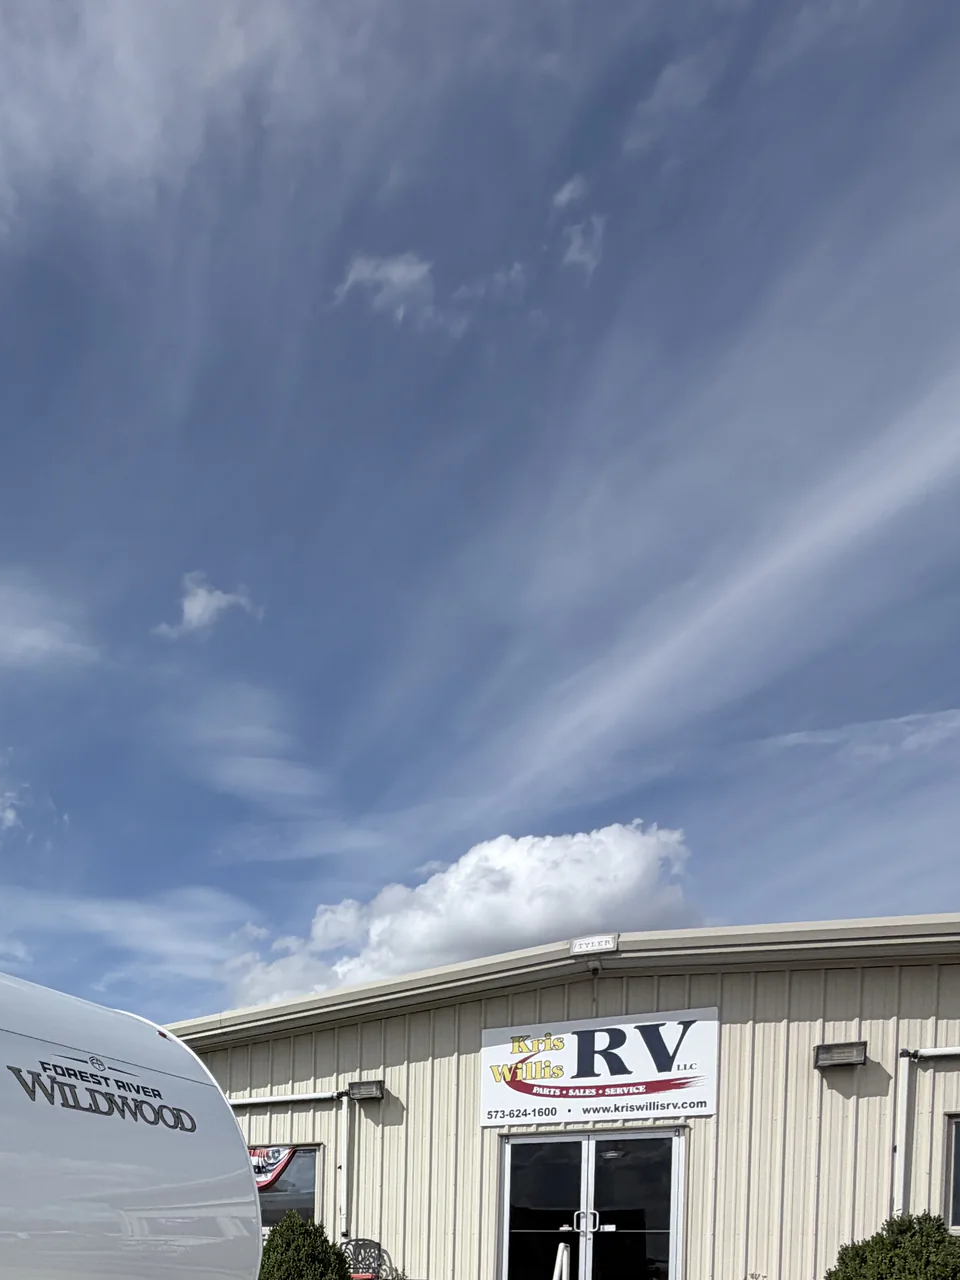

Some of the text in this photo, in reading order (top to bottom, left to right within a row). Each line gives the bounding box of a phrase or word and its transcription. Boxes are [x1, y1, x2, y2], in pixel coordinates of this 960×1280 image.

[578, 939, 611, 949] TYLER
[510, 1032, 565, 1055] Kris
[570, 1020, 698, 1080] RV
[489, 1060, 565, 1084] Willis
[676, 1062, 698, 1072] LLC
[38, 1060, 164, 1101] FOREST RIVER
[532, 1085, 647, 1096] PARTS SALES SERVICE
[6, 1065, 197, 1133] WILDWOOD
[486, 1099, 708, 1120] 573-624-1600 www.kriswillisrv.com
